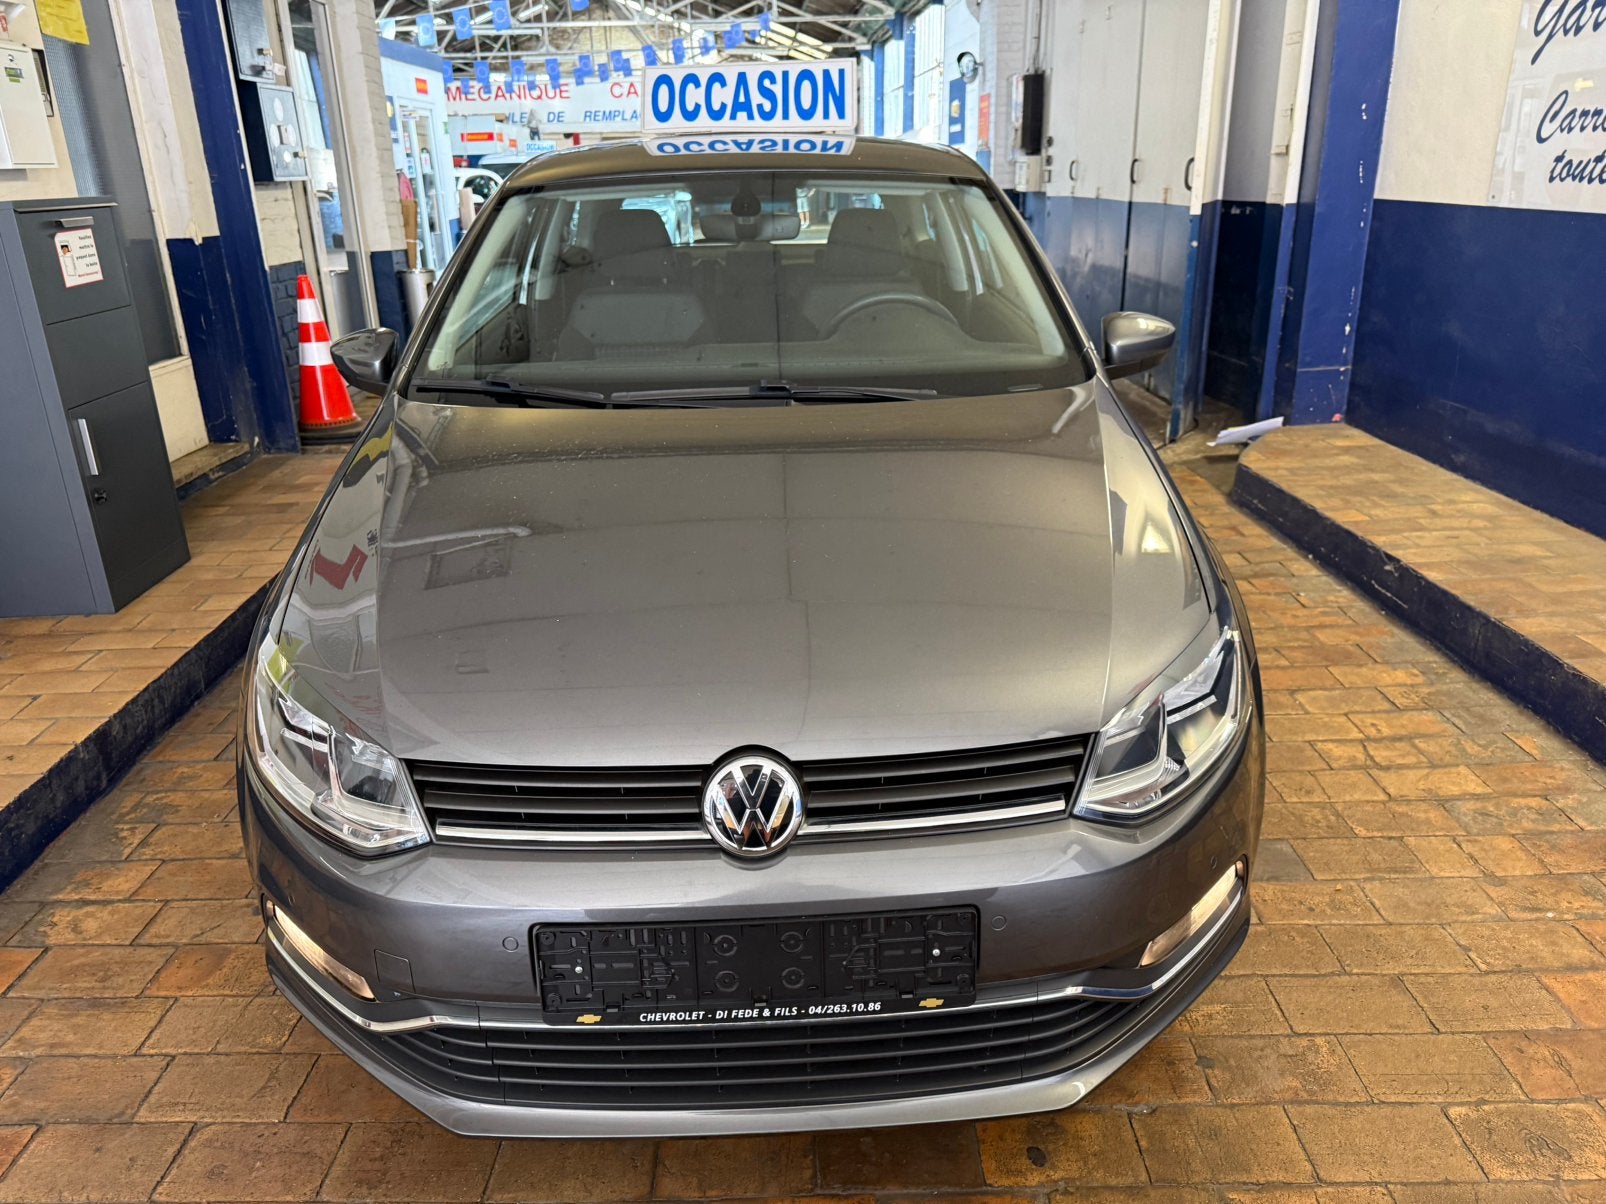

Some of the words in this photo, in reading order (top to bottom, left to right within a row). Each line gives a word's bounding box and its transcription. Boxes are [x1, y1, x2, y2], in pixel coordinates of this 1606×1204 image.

[651, 68, 846, 123] OCCASION
[547, 111, 565, 123] DE
[584, 109, 641, 122] REMPLA
[1536, 89, 1606, 144] Carr
[639, 1011, 705, 1022] CHEVROLET
[715, 1010, 728, 1020] DI
[731, 1008, 760, 1019] FEDE
[762, 1008, 771, 1018] &
[774, 1006, 798, 1017] FILS
[808, 1002, 882, 1015] 04/263.10.86
